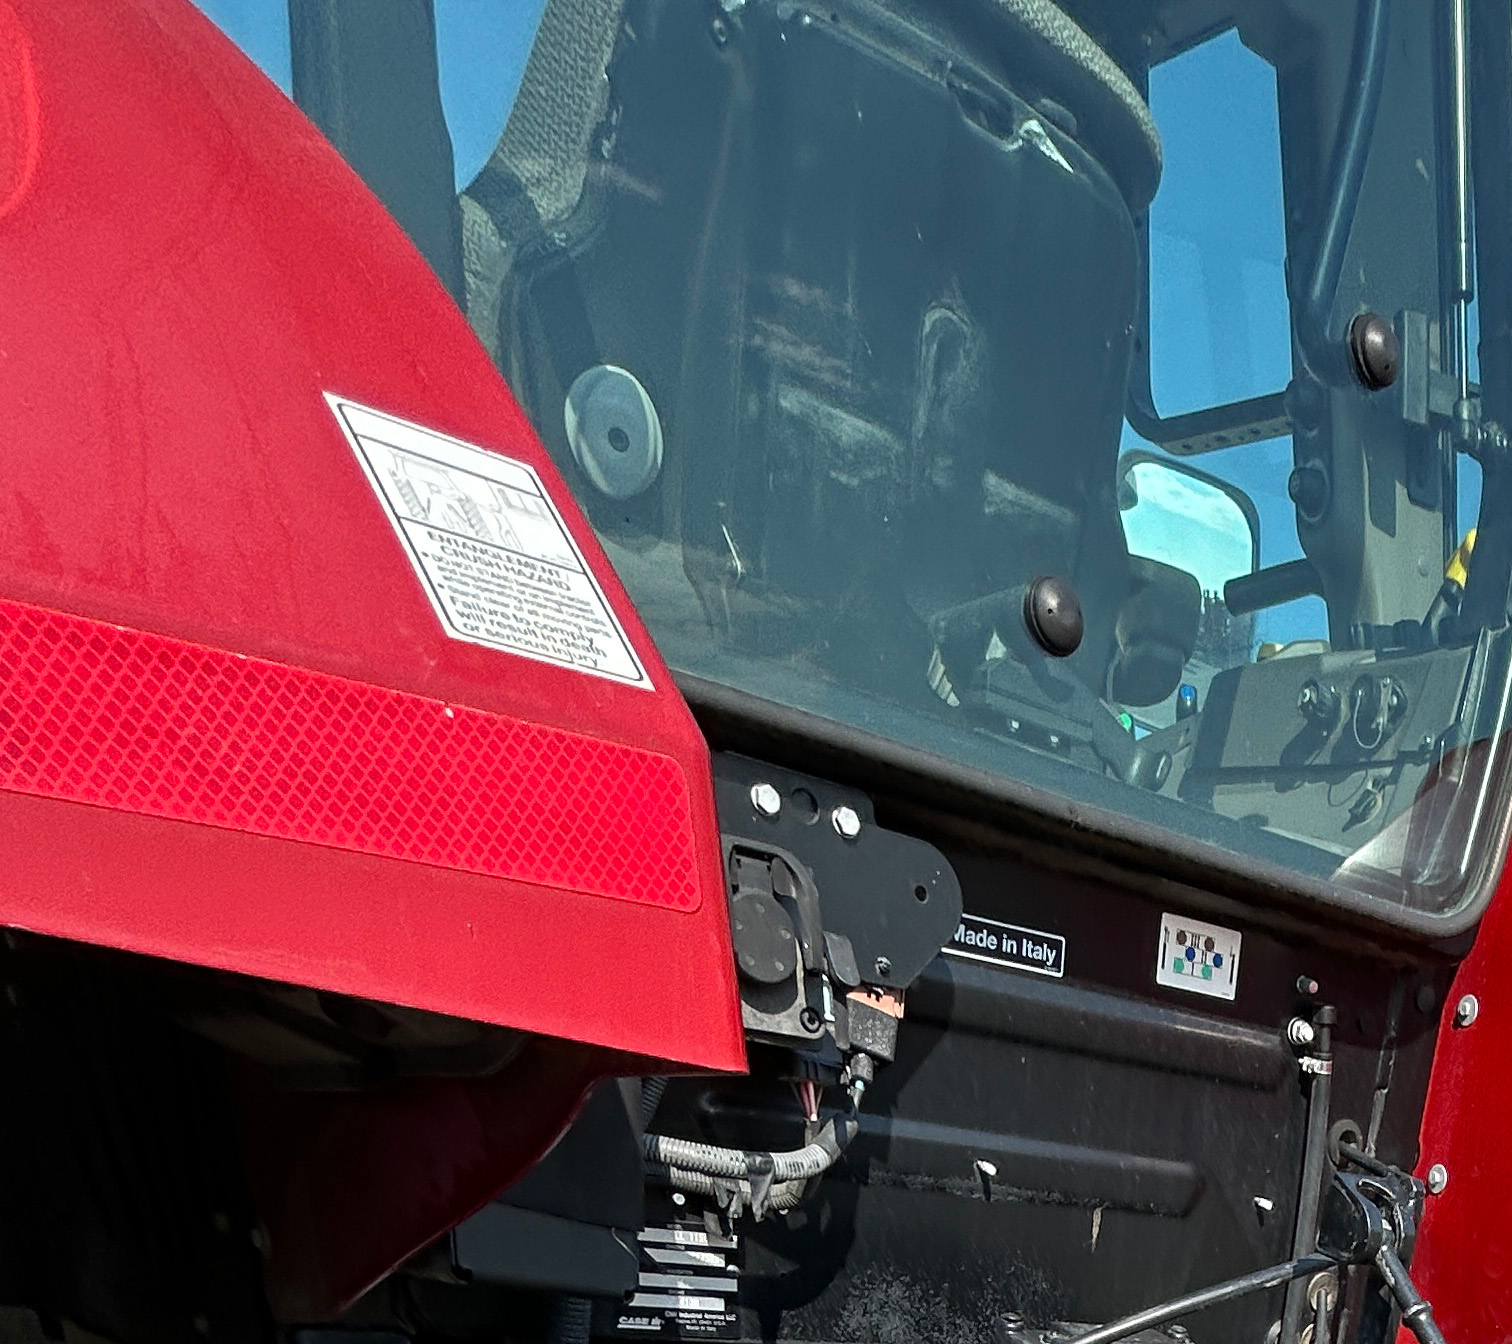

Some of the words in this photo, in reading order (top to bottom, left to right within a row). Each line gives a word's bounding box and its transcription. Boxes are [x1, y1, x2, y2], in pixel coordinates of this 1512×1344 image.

[503, 565, 571, 590] HAZARD
[449, 596, 510, 619] Failure
[532, 620, 595, 645] comply
[454, 607, 487, 624] will
[488, 617, 538, 637] result
[558, 637, 606, 655] death
[484, 627, 549, 650] serious
[1002, 933, 1017, 955] in
[1022, 938, 1056, 966] Italy
